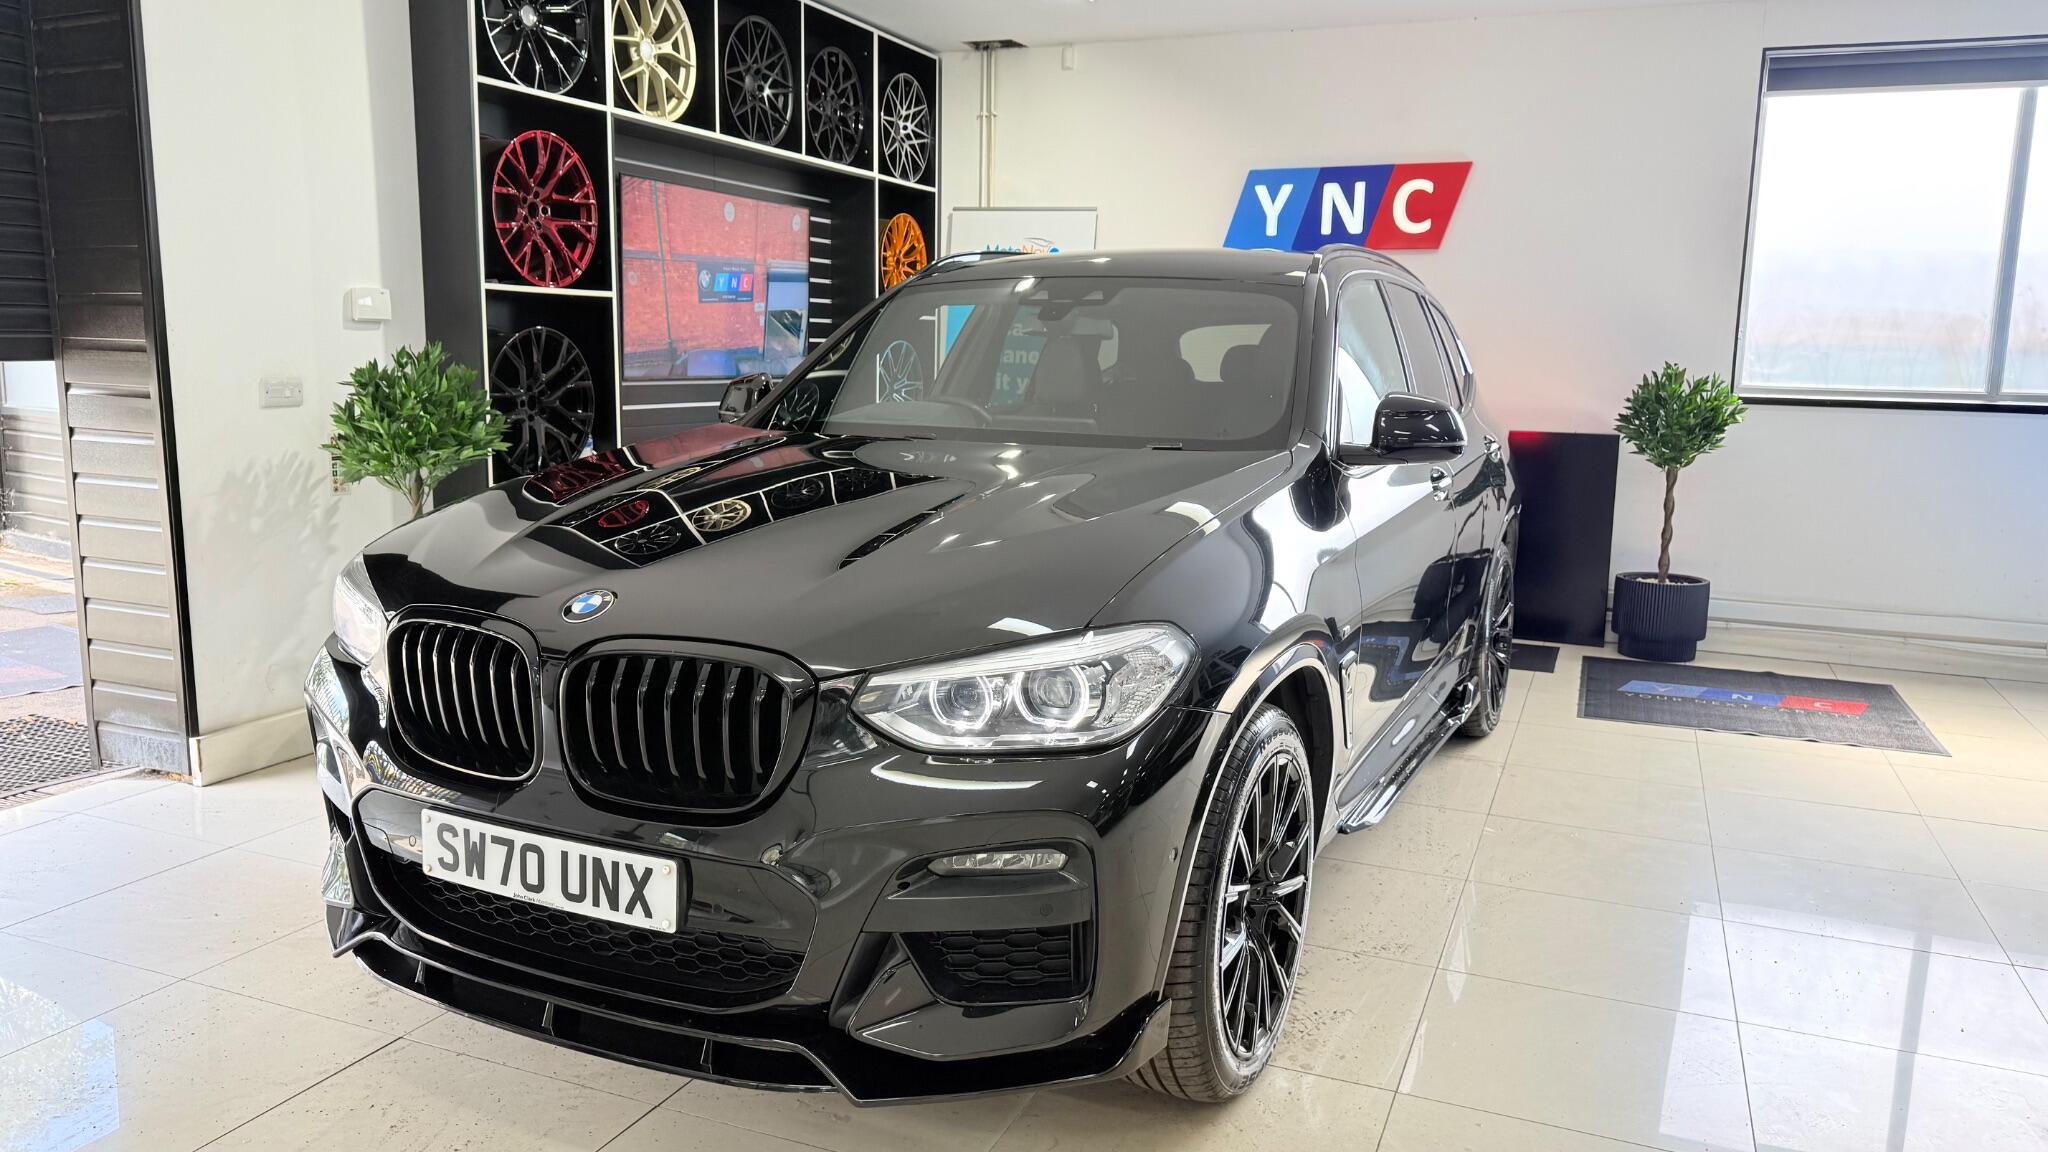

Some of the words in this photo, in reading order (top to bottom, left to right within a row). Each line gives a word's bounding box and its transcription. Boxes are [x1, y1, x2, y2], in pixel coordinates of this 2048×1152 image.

[1254, 178, 1434, 237] YNC
[436, 822, 545, 894] SW70
[560, 850, 654, 919] UNX
